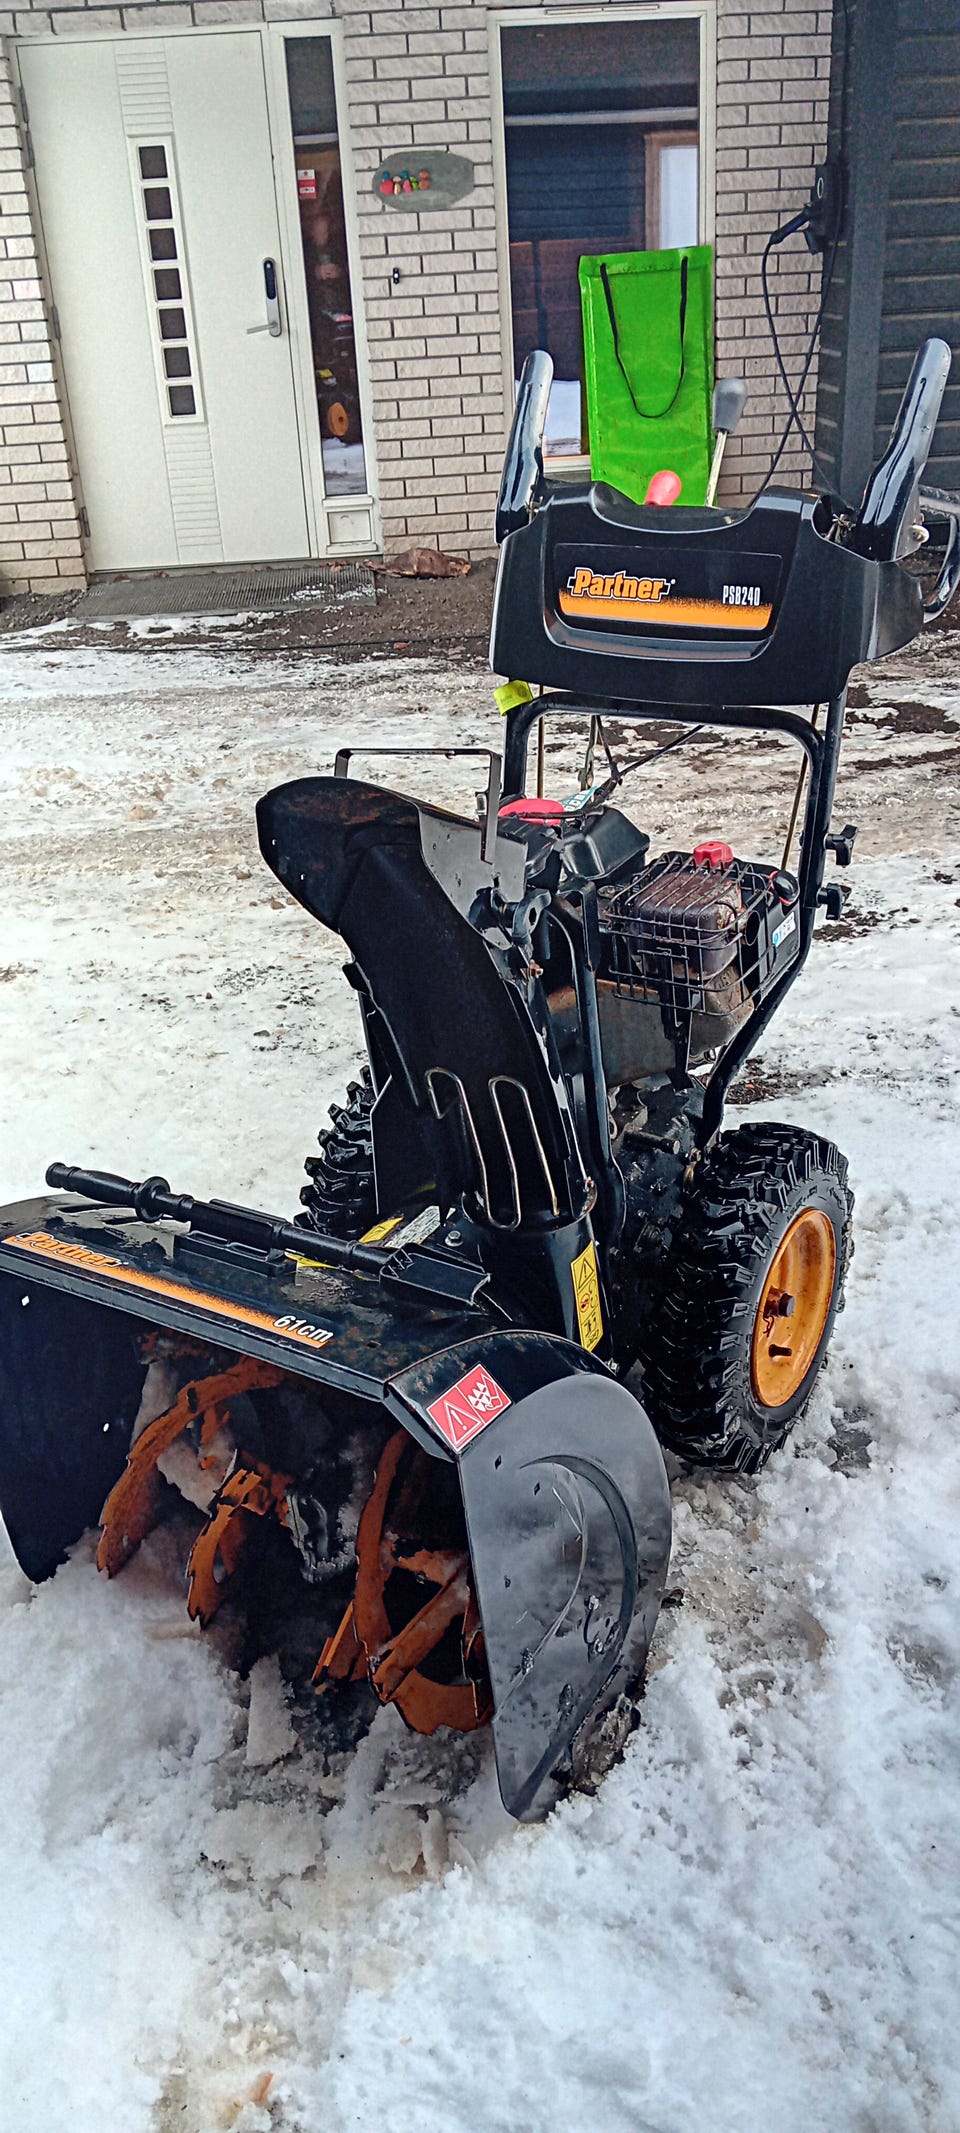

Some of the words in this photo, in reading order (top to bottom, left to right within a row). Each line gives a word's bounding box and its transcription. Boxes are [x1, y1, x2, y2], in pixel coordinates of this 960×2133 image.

[569, 568, 668, 602] Partner
[722, 585, 761, 606] PSB240
[16, 1231, 121, 1267] Partner
[273, 1315, 334, 1343] 61cm
